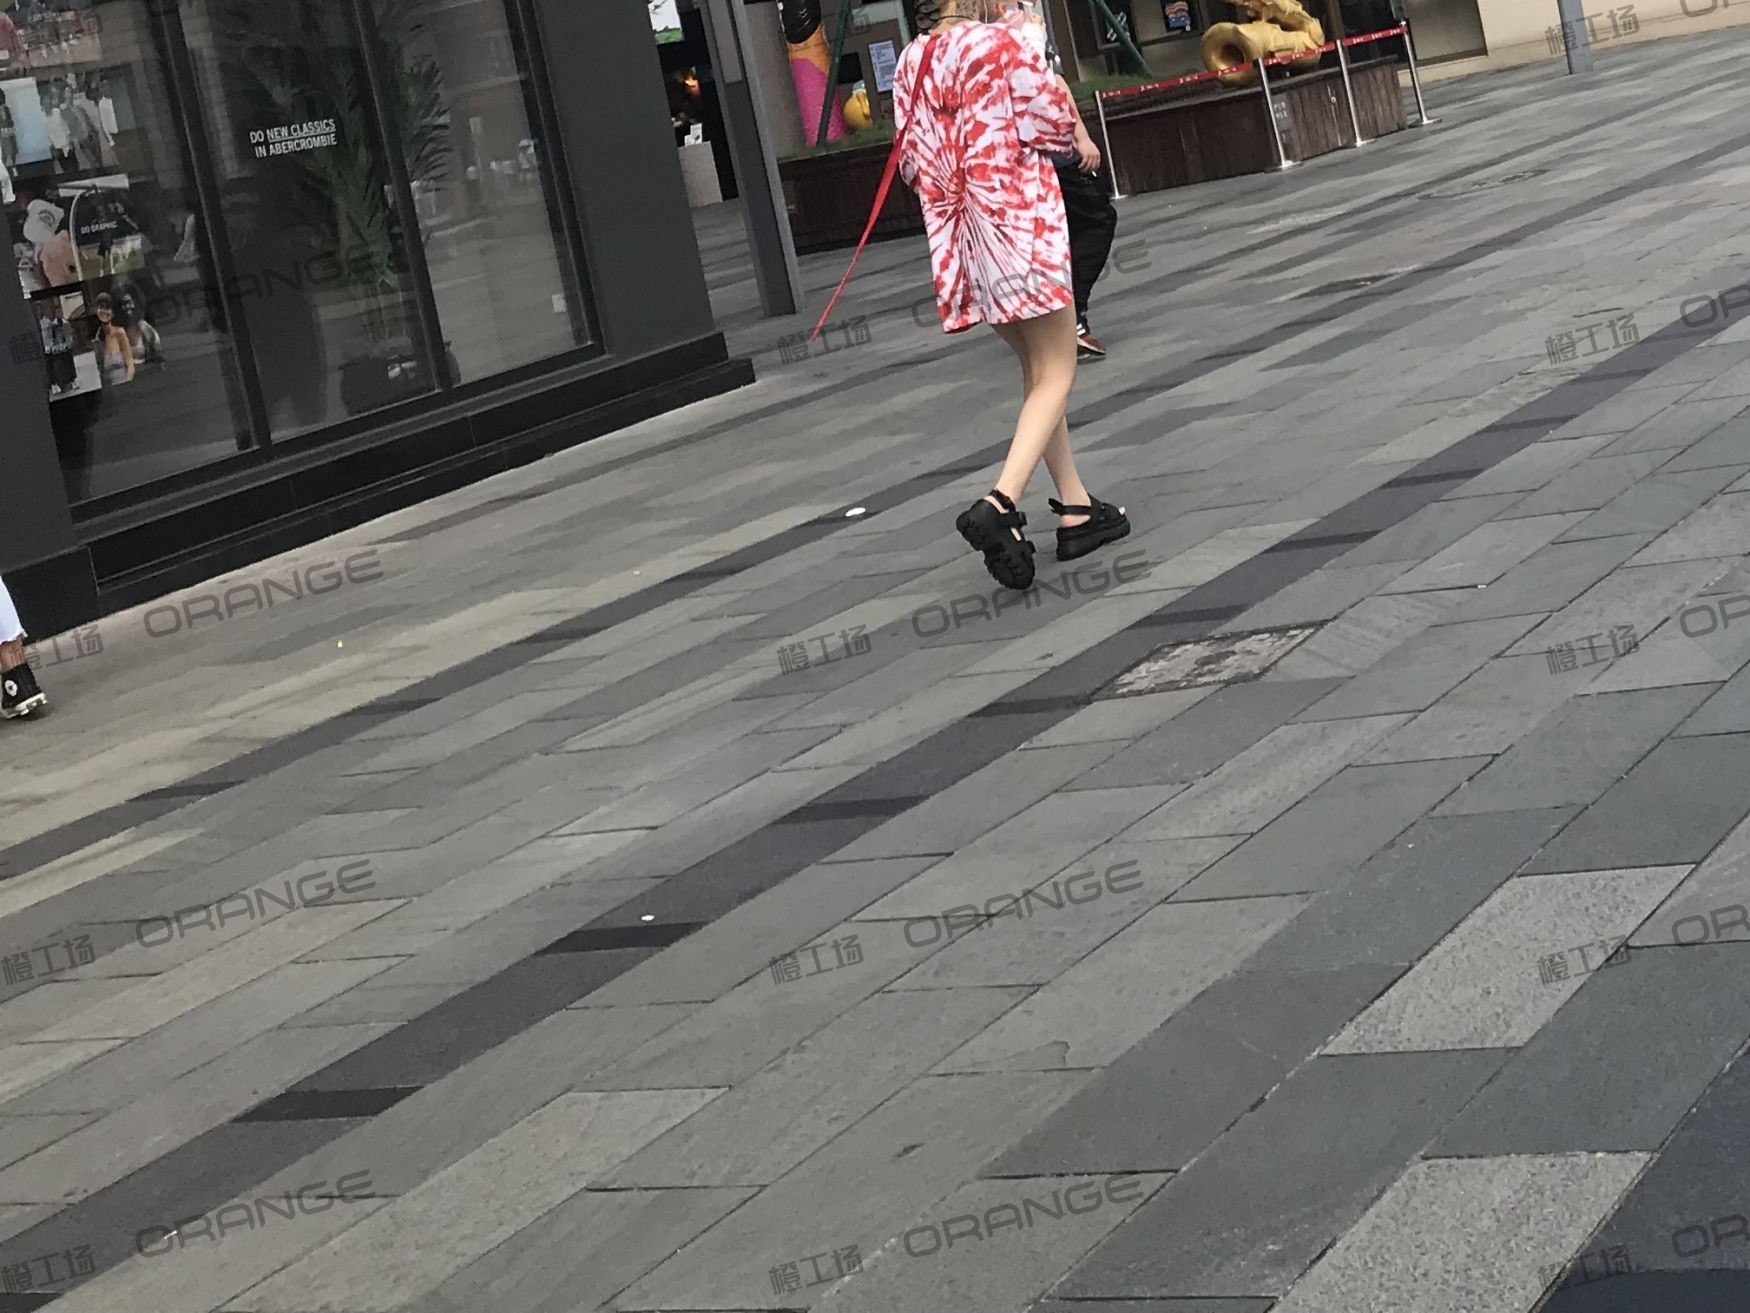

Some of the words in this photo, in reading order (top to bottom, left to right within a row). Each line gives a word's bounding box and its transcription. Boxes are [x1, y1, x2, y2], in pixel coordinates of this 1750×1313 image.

[250, 130, 264, 144] DO
[266, 126, 288, 141] NEW
[290, 119, 336, 136] CLASSICS
[254, 145, 267, 159] IN
[269, 133, 338, 156] ABERCROMBIE
